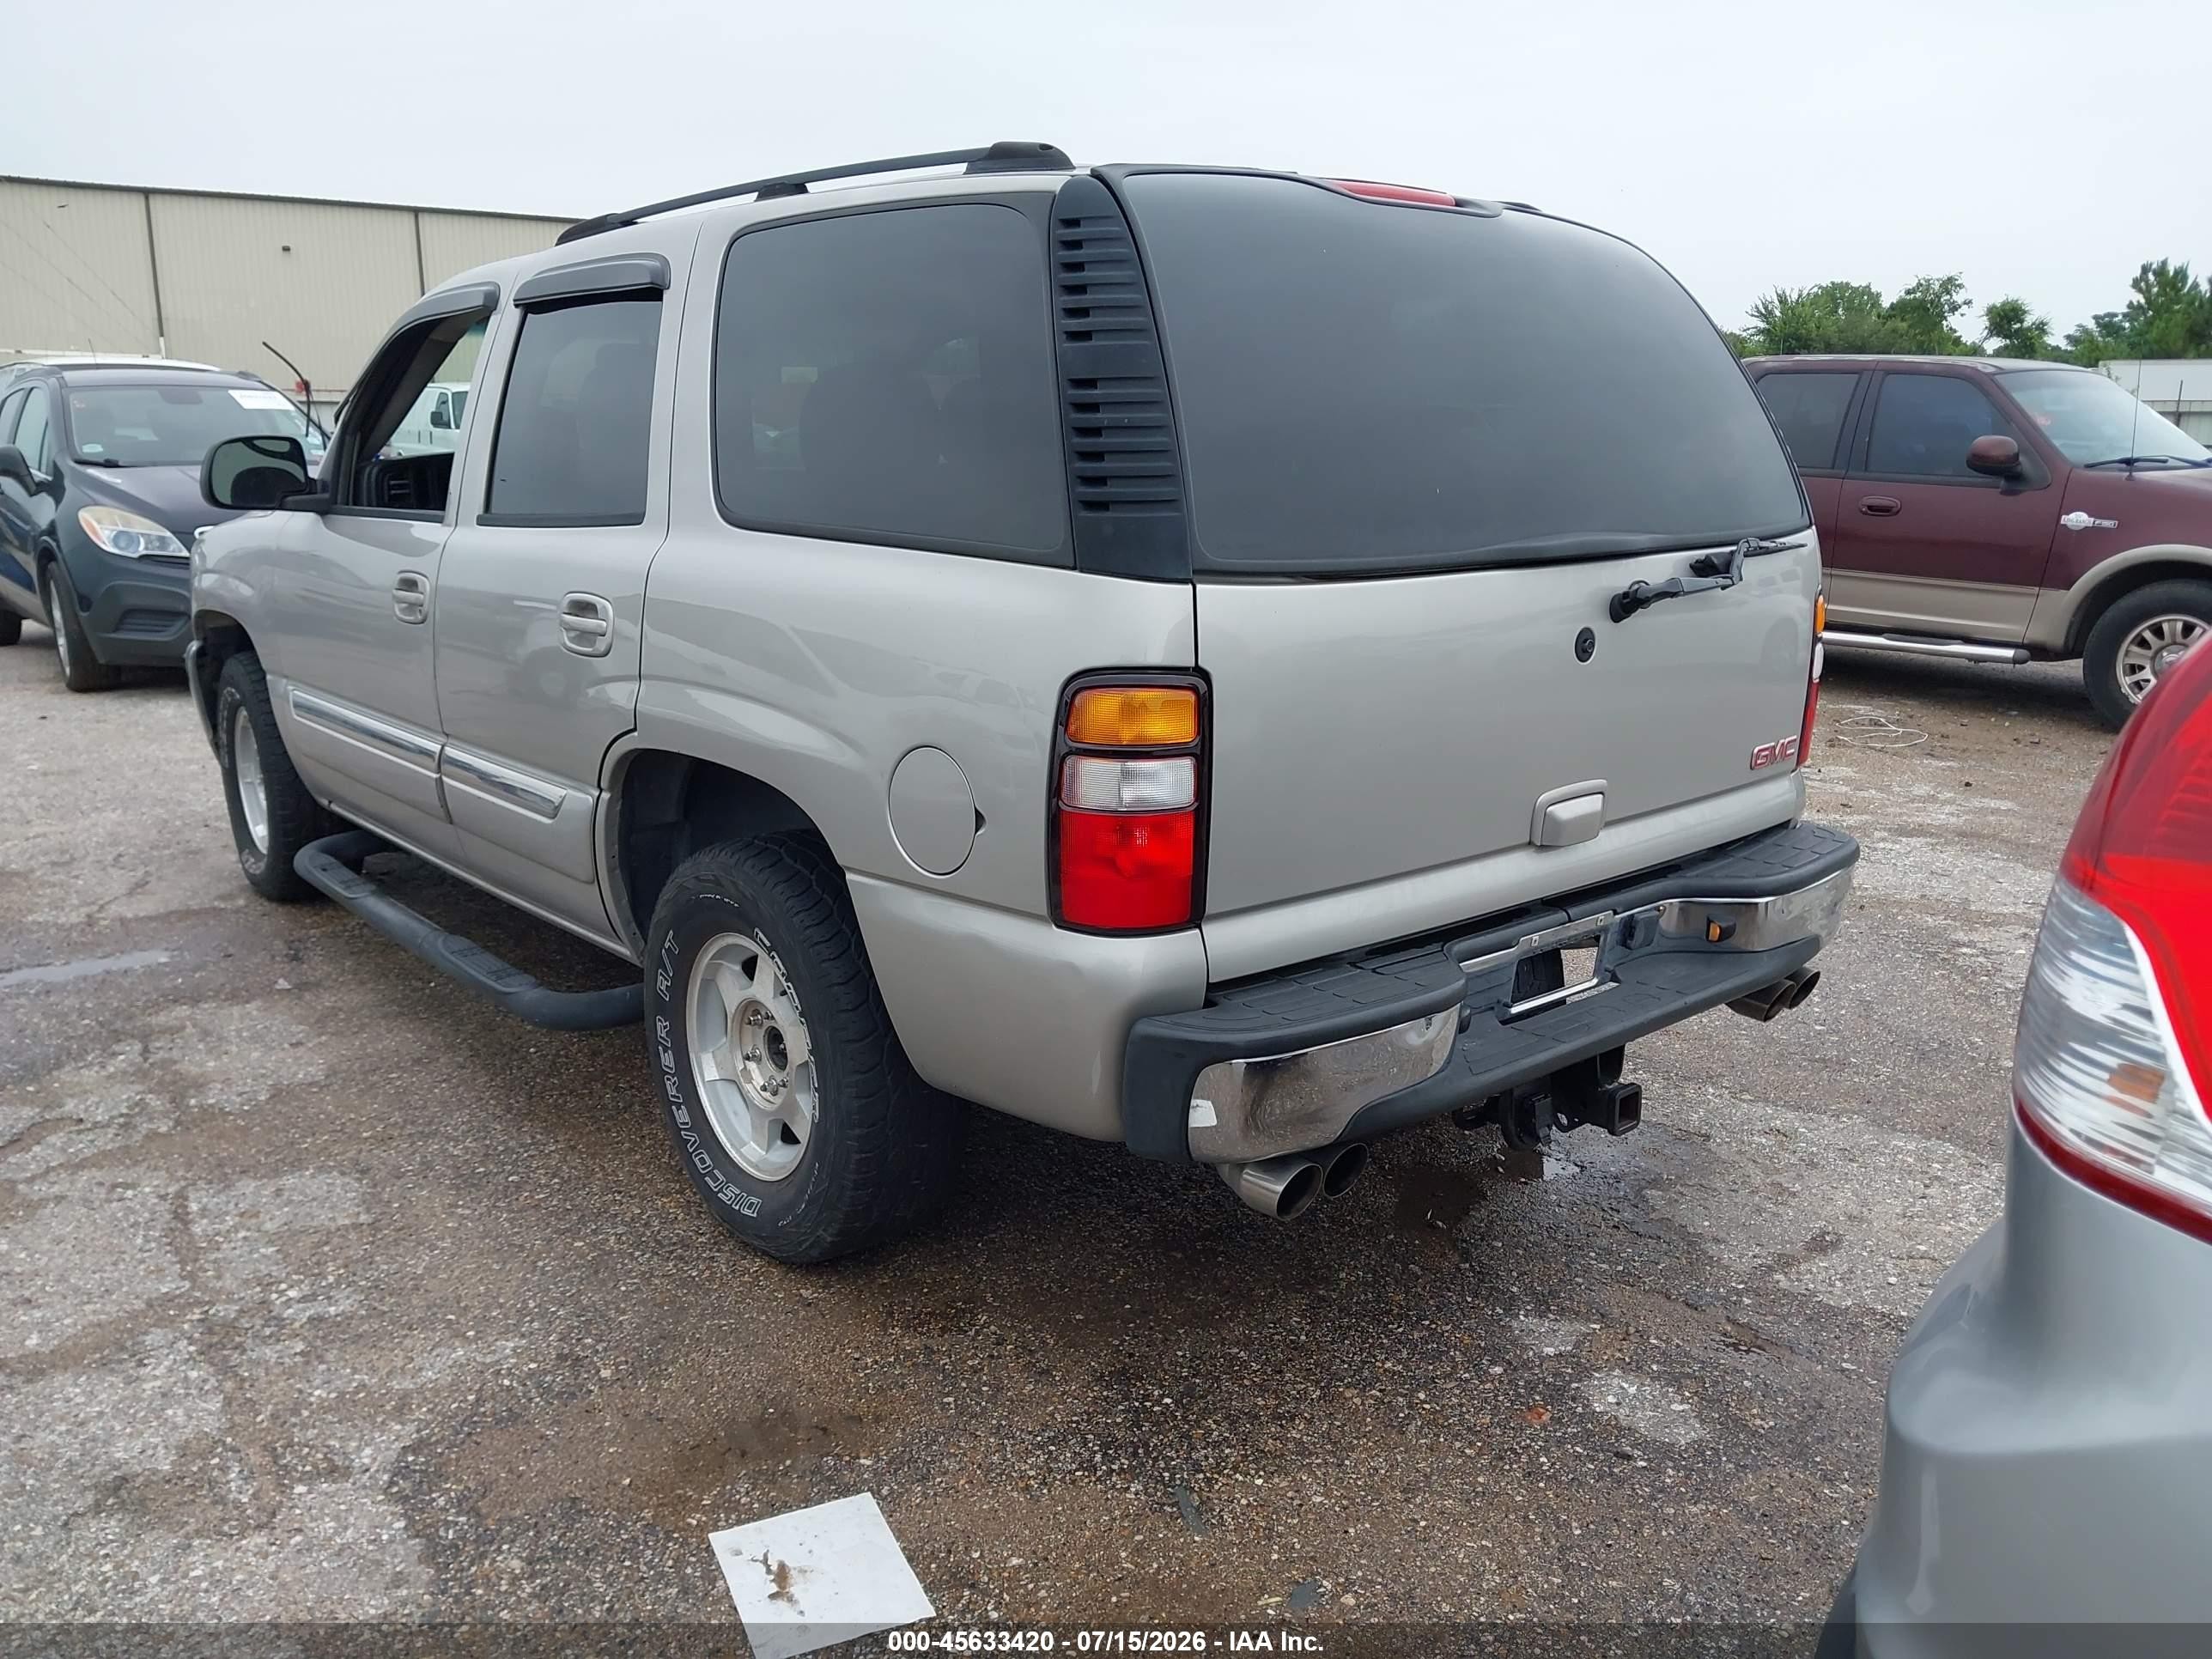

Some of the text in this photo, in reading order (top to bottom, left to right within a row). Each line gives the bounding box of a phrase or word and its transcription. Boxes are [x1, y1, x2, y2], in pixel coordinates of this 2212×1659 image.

[1751, 735, 1797, 770] GMC
[656, 929, 763, 1218] DISCOVERER A/T
